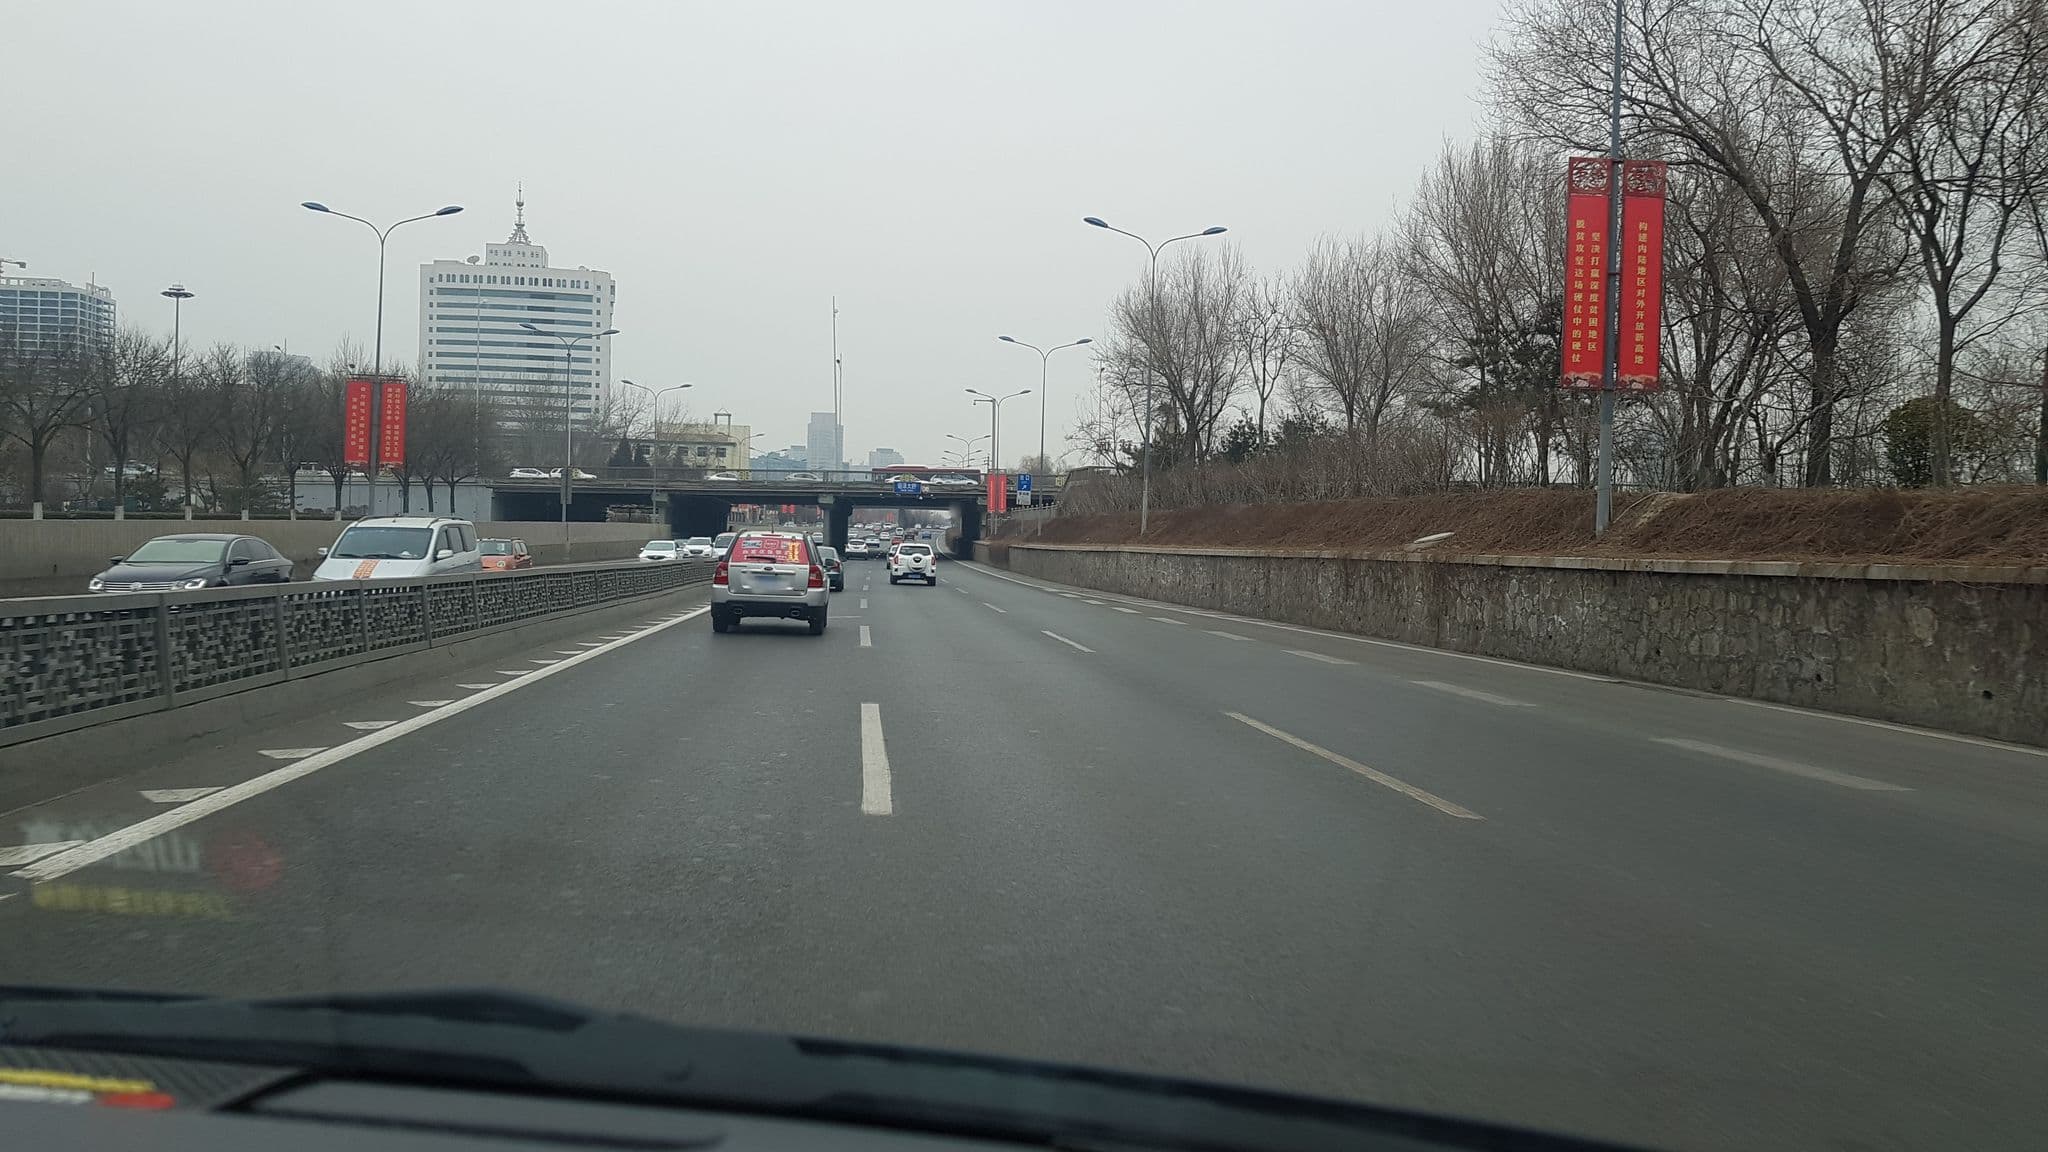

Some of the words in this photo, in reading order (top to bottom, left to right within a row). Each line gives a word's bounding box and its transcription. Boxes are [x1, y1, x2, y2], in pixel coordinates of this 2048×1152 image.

[1634, 221, 1649, 365] 构建内陆地区对外开放新高地
